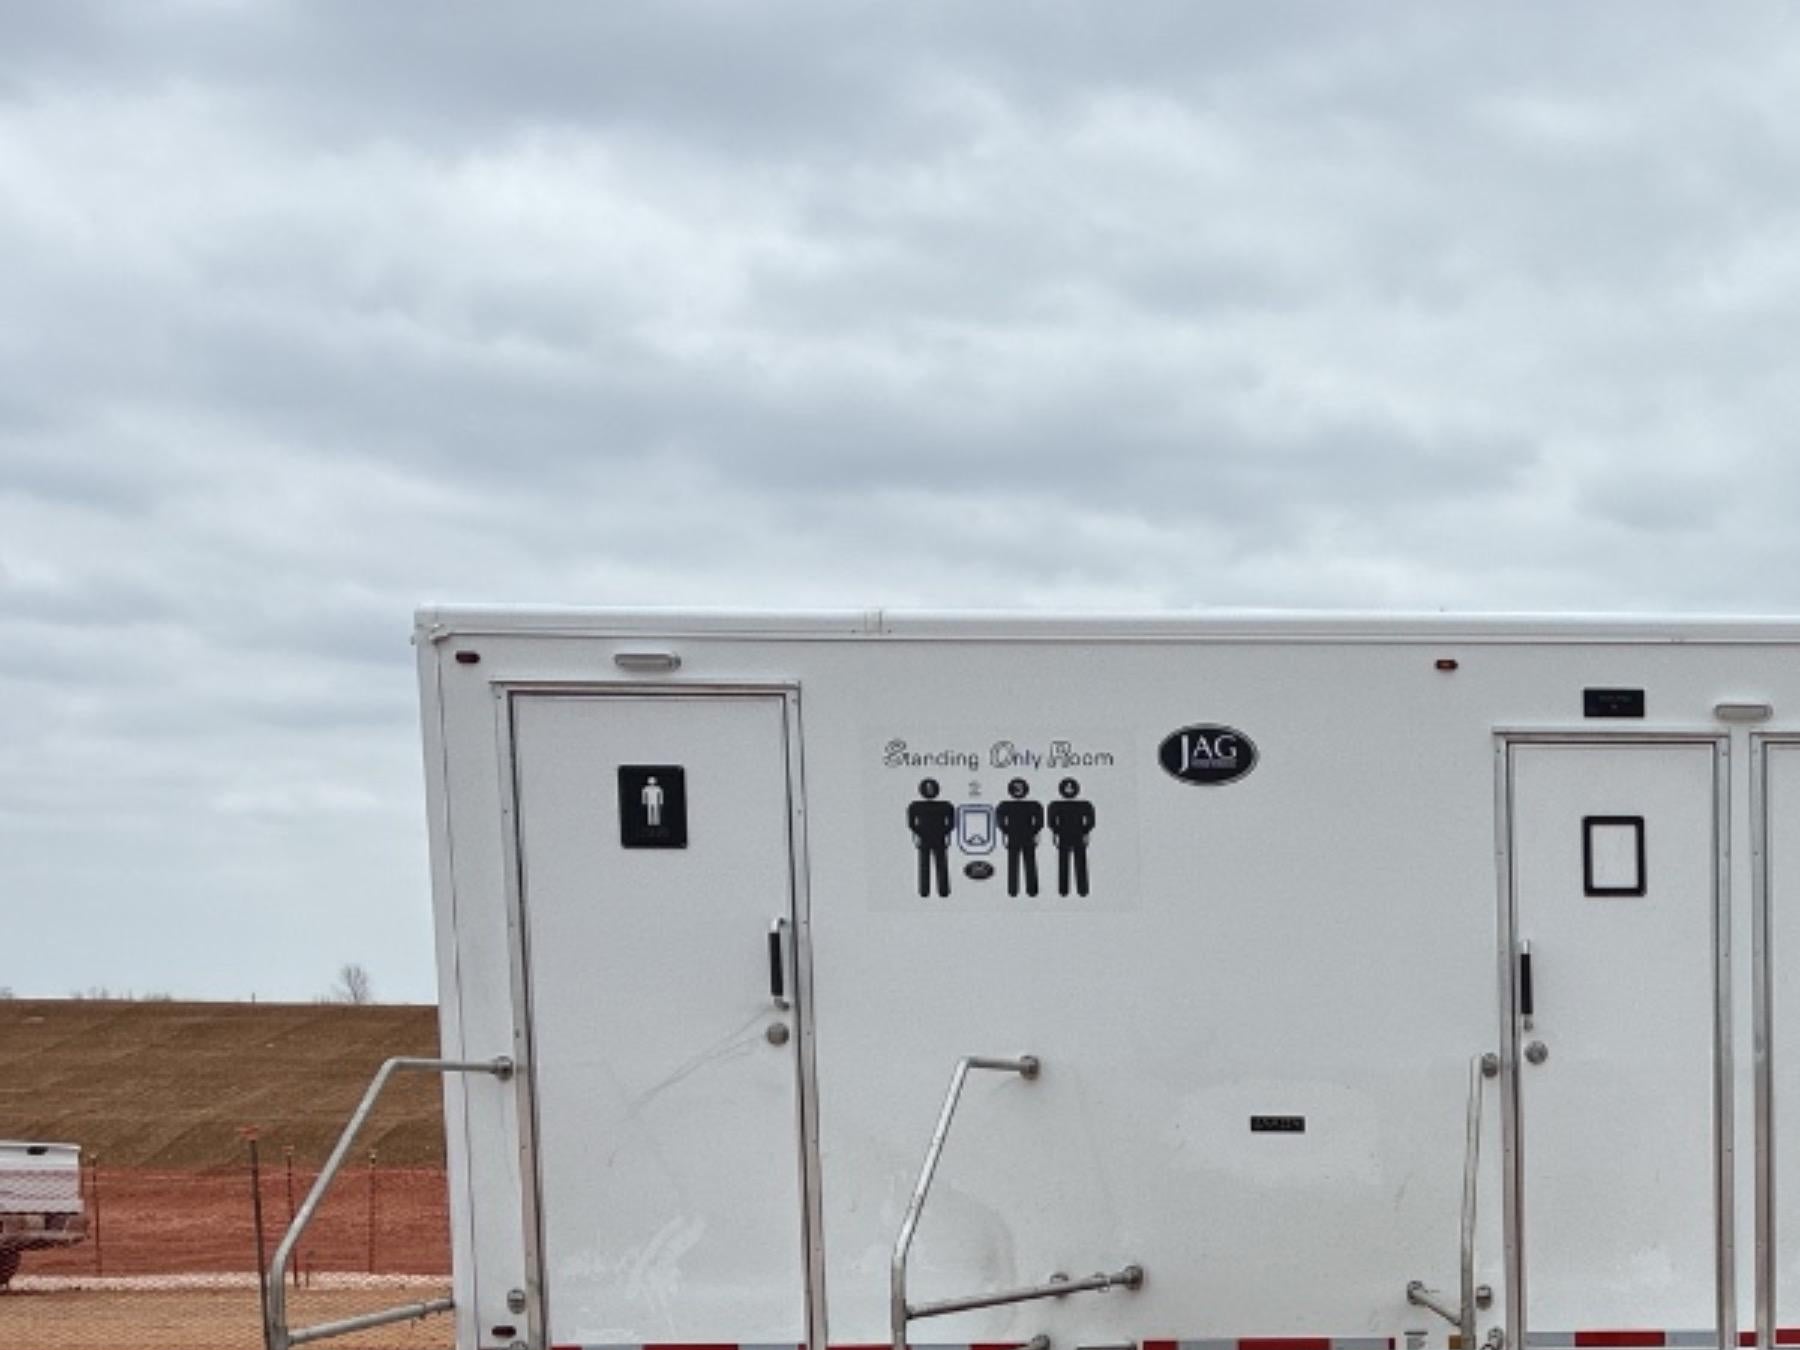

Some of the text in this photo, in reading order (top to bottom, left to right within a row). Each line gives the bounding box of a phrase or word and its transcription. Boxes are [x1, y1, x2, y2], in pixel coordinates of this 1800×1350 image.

[884, 738, 1114, 770] Standing Only Room
[1180, 734, 1237, 773] JAG
